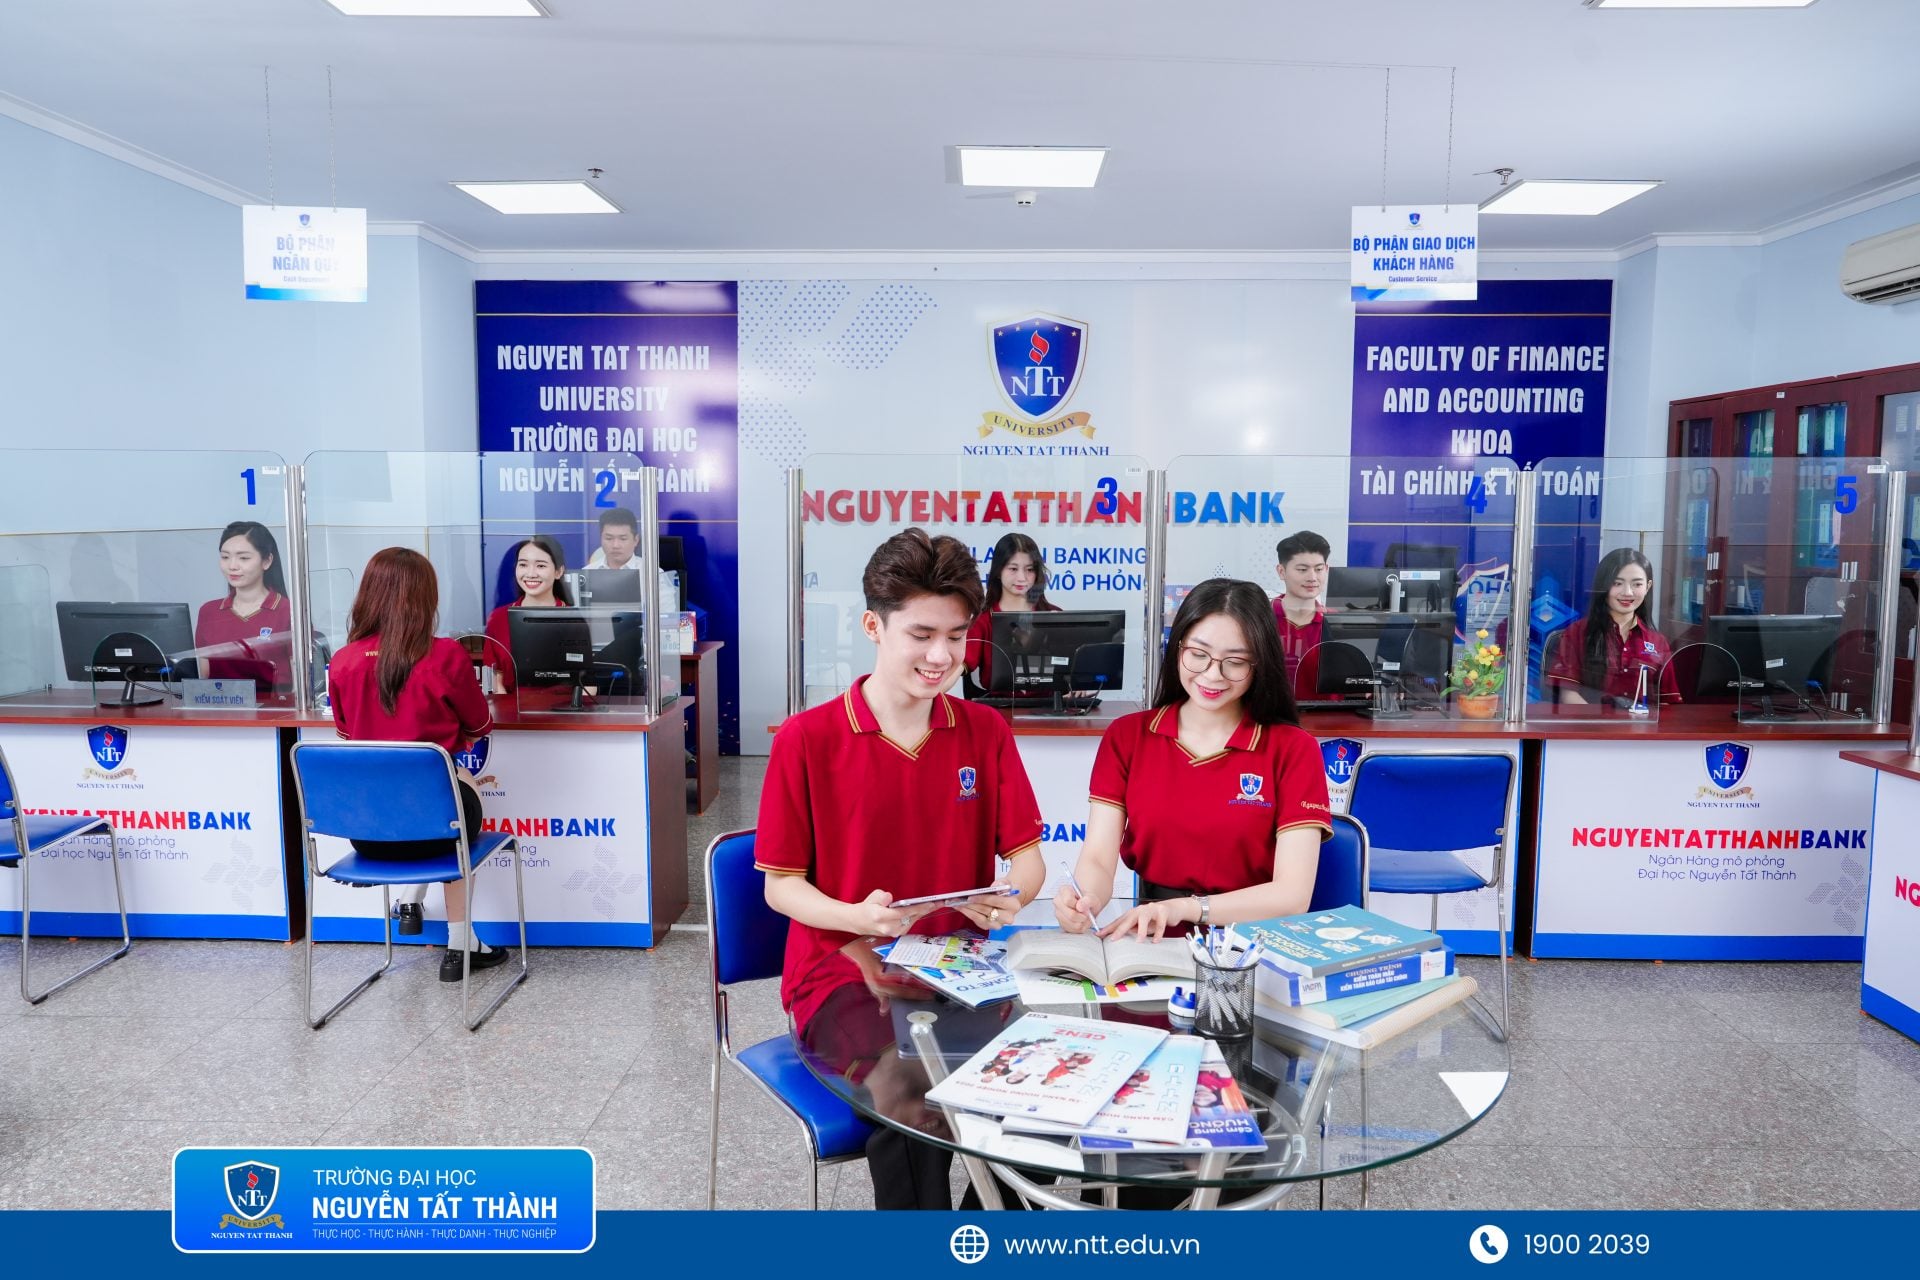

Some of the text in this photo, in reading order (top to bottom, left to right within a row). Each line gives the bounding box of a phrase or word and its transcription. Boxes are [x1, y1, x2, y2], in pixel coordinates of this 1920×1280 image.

[277, 234, 294, 254] BỘ
[1353, 234, 1476, 254] BỘ PHẬN GIAO DỊCH
[272, 253, 310, 271] NGÂN
[1374, 254, 1454, 271] KHÁCH HÀNG
[497, 345, 710, 370] NGUYEN TAT THANH
[1366, 346, 1605, 372] FACULTY OF FINANCE
[1010, 366, 1064, 396] NTT
[540, 386, 669, 412] UNIVERSITY
[1383, 388, 1584, 414] AND ACCOUNTING
[994, 415, 1076, 436] UNIVERSITY
[510, 422, 697, 458] TRƯỜNG ĐẠI HỌC
[963, 446, 1110, 456] NGUYEN TAT THANH
[1452, 429, 1513, 454] KHOA
[240, 468, 256, 505] 1
[500, 458, 584, 492] NGUYỄN
[656, 463, 710, 493] HÀNH
[1360, 465, 1395, 496] TÀI
[1404, 466, 1474, 496] CHÍNH
[1542, 465, 1600, 496] TOÁN
[594, 470, 617, 508] 2
[1096, 476, 1118, 515] 3
[1464, 476, 1488, 514] 4
[1834, 476, 1858, 514] 5
[802, 489, 1285, 524] NGUYENTATTHANBANK
[1055, 548, 1146, 564] BANKING
[1083, 569, 1146, 591] PHỎN
[194, 694, 210, 704] KIỂM
[230, 694, 244, 704] VIÊN
[96, 747, 121, 762] NTT
[456, 754, 482, 769] NTT
[1713, 764, 1740, 780] NTT
[118, 836, 134, 846] mô
[138, 835, 176, 848] phỏng
[1572, 827, 1867, 849] NGUYENTATTHANHBANK
[62, 848, 84, 860] học
[135, 848, 150, 860] Tất
[154, 848, 188, 860] Thành
[1648, 854, 1784, 868] Ngân Hàng mô phỏng
[1638, 868, 1796, 882] Đại học Nguyễn Tất Thành
[1054, 1028, 1106, 1041] GENZ
